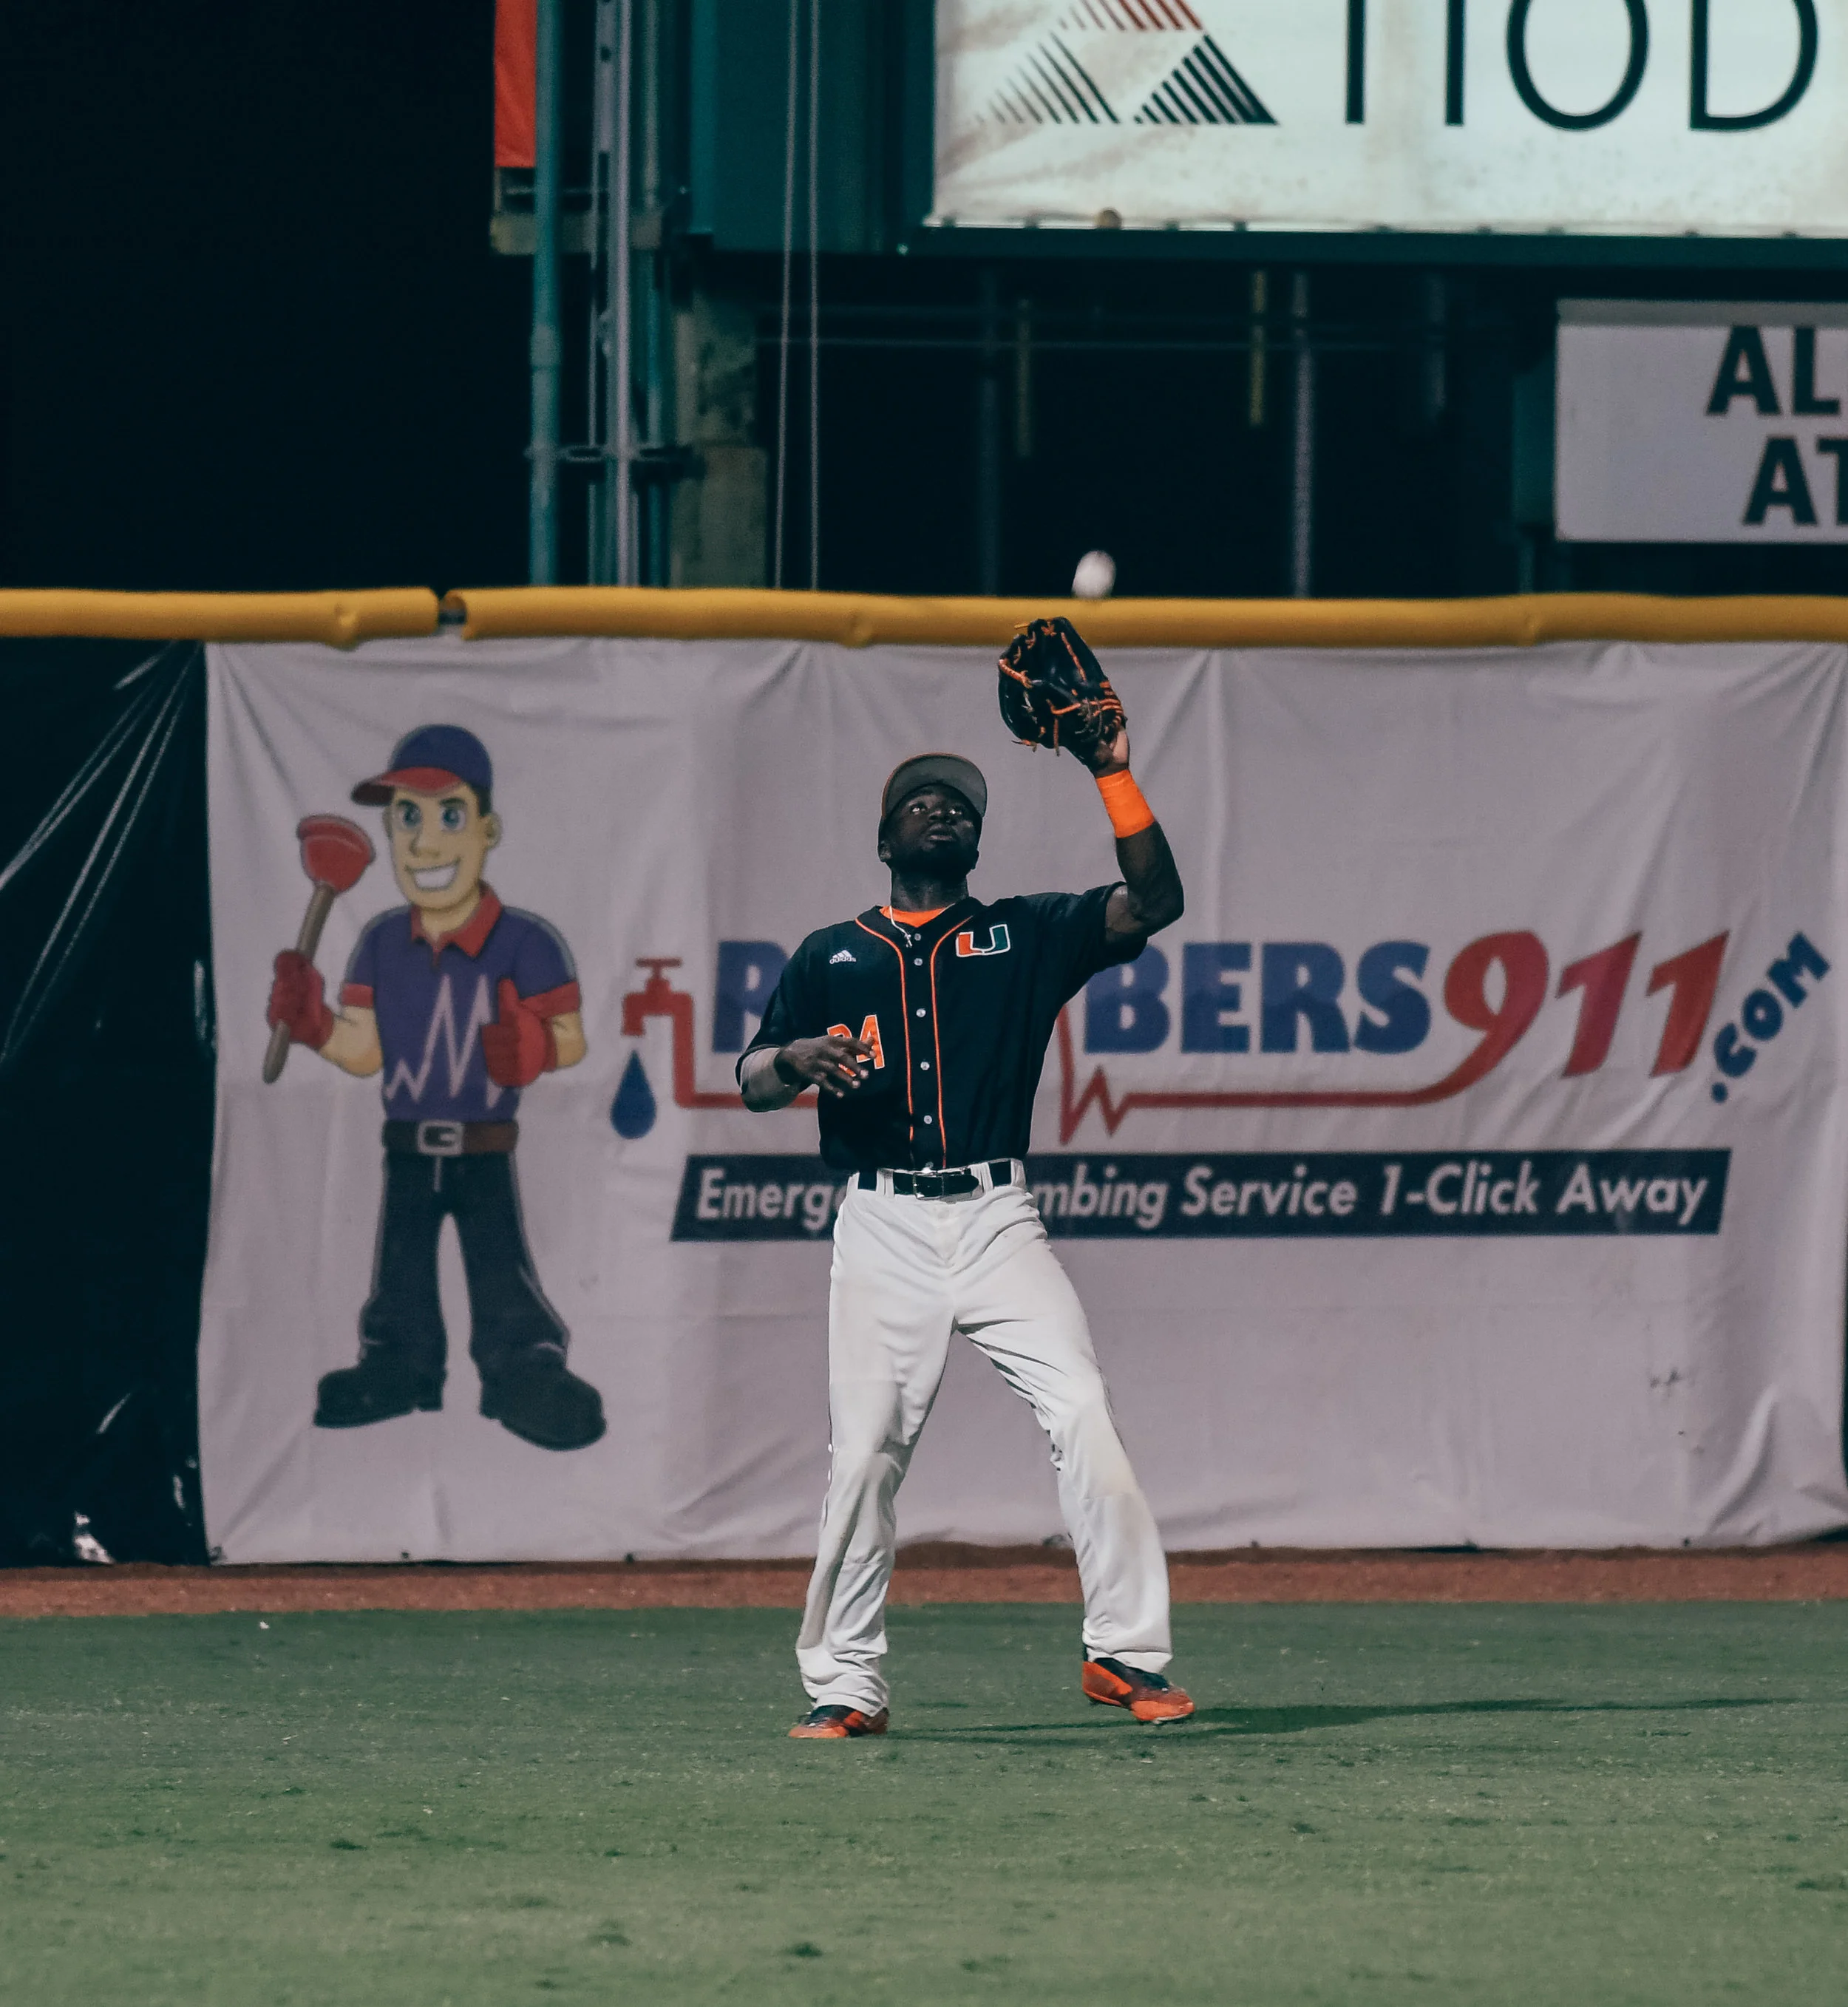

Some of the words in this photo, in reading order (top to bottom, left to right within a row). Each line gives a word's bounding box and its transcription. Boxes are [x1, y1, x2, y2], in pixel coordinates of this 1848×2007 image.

[1705, 325, 1841, 417] AL
[1181, 1164, 1358, 1216] Service
[1379, 1160, 1539, 1215] 1-Click
[1556, 1163, 1708, 1226] Away
